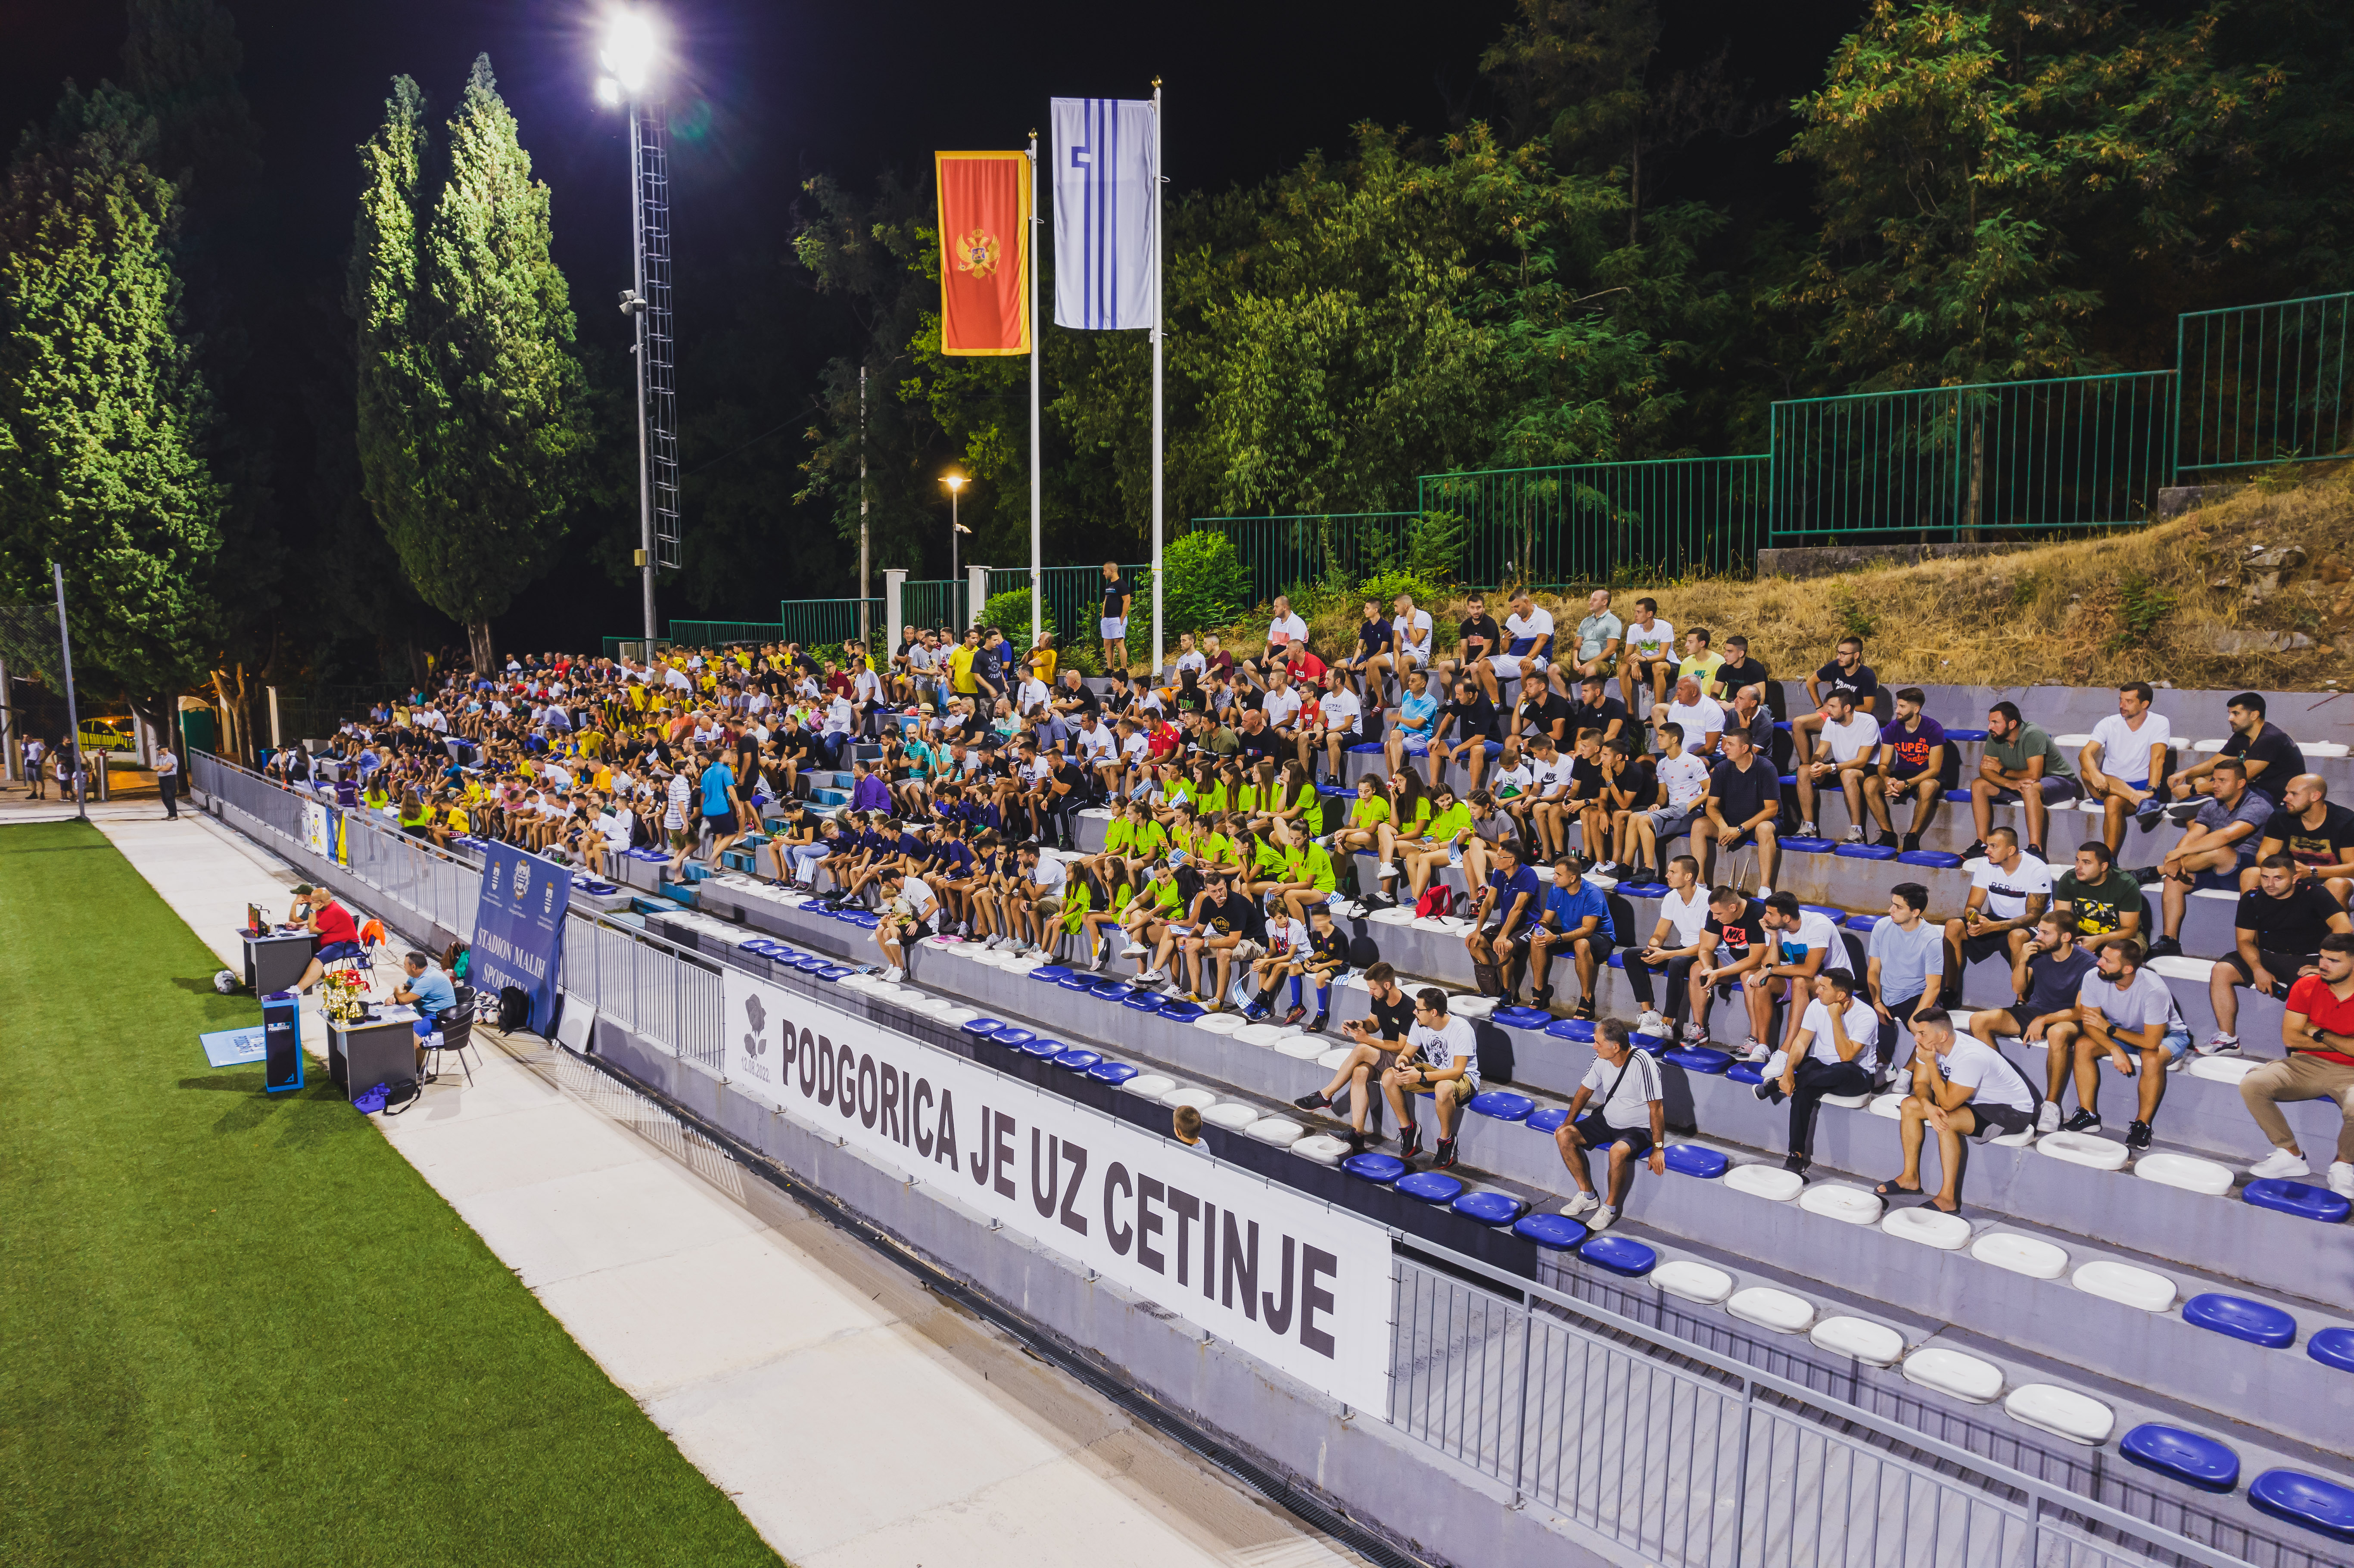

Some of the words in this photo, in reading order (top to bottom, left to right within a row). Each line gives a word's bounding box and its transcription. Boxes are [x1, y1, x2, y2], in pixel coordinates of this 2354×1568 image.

[1894, 742, 1929, 753] SUPER
[476, 927, 513, 962] STADION
[513, 946, 546, 980] MALIH
[741, 1055, 771, 1084] 12.08.2022.
[783, 1018, 959, 1173] PODGORICA
[970, 1105, 1015, 1201] JE
[1031, 1126, 1087, 1237] UZ
[1103, 1161, 1337, 1360] CETINJE
